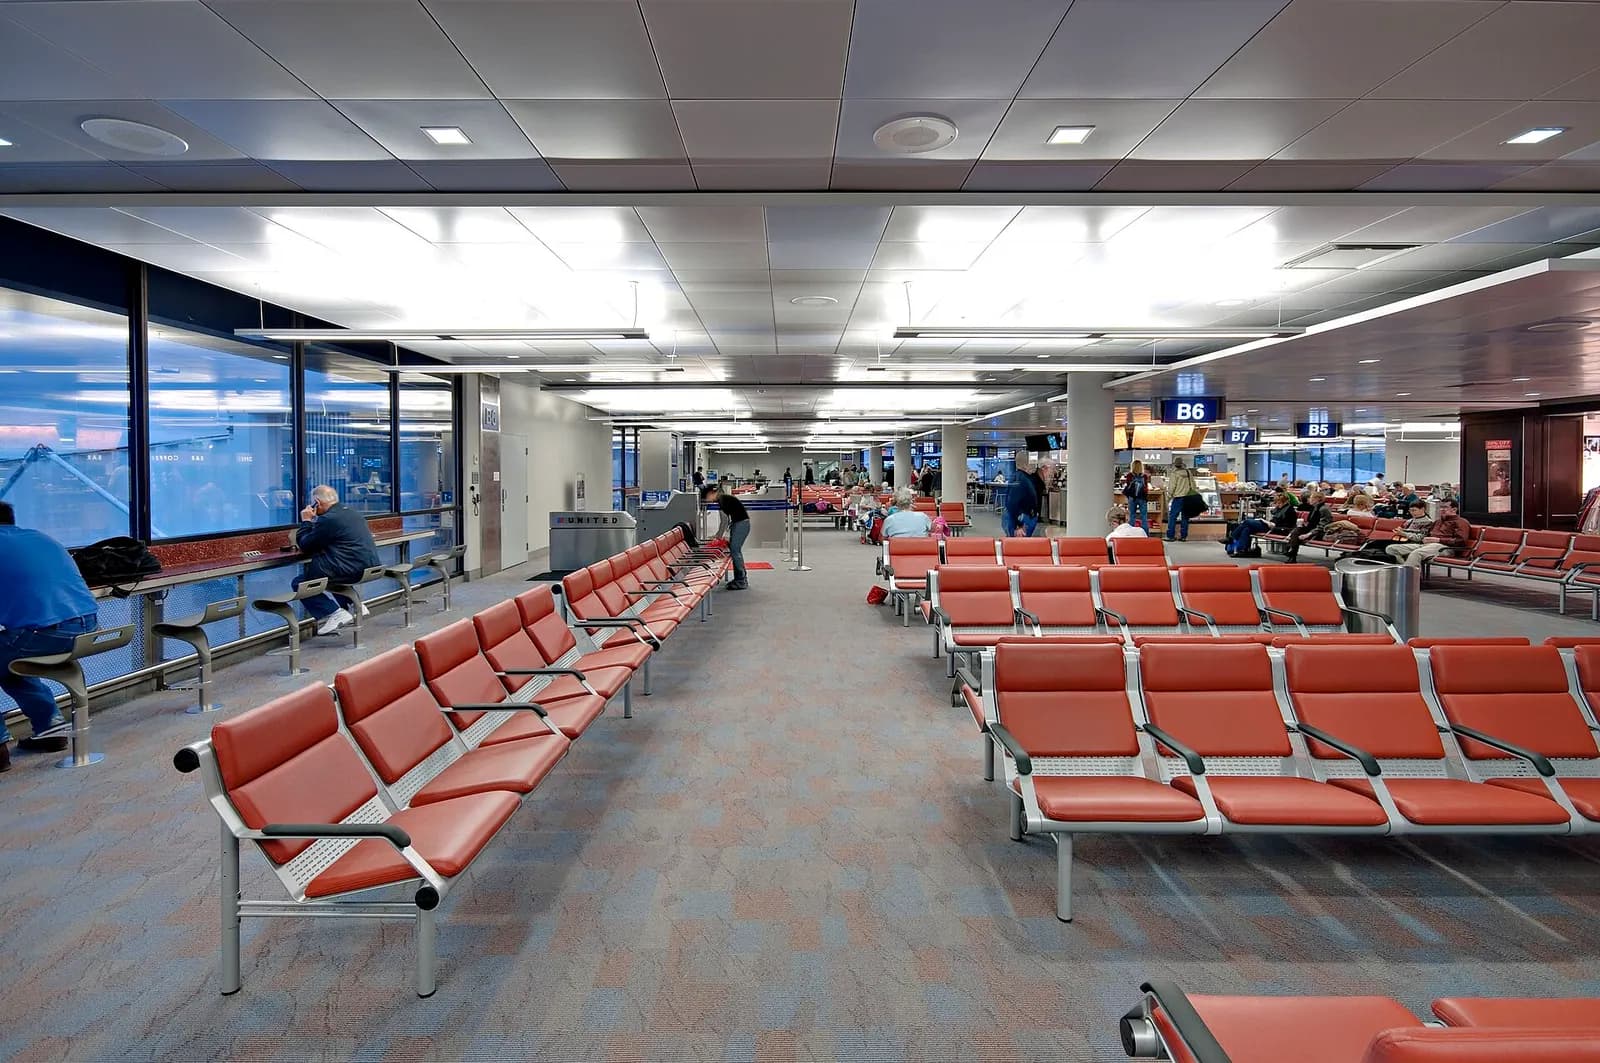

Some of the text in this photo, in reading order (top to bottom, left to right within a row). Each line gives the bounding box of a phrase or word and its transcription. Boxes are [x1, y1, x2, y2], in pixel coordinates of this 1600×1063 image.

[484, 407, 497, 426] B6
[1177, 403, 1205, 420] B6
[1231, 431, 1249, 442] B7
[1309, 424, 1329, 436] B5
